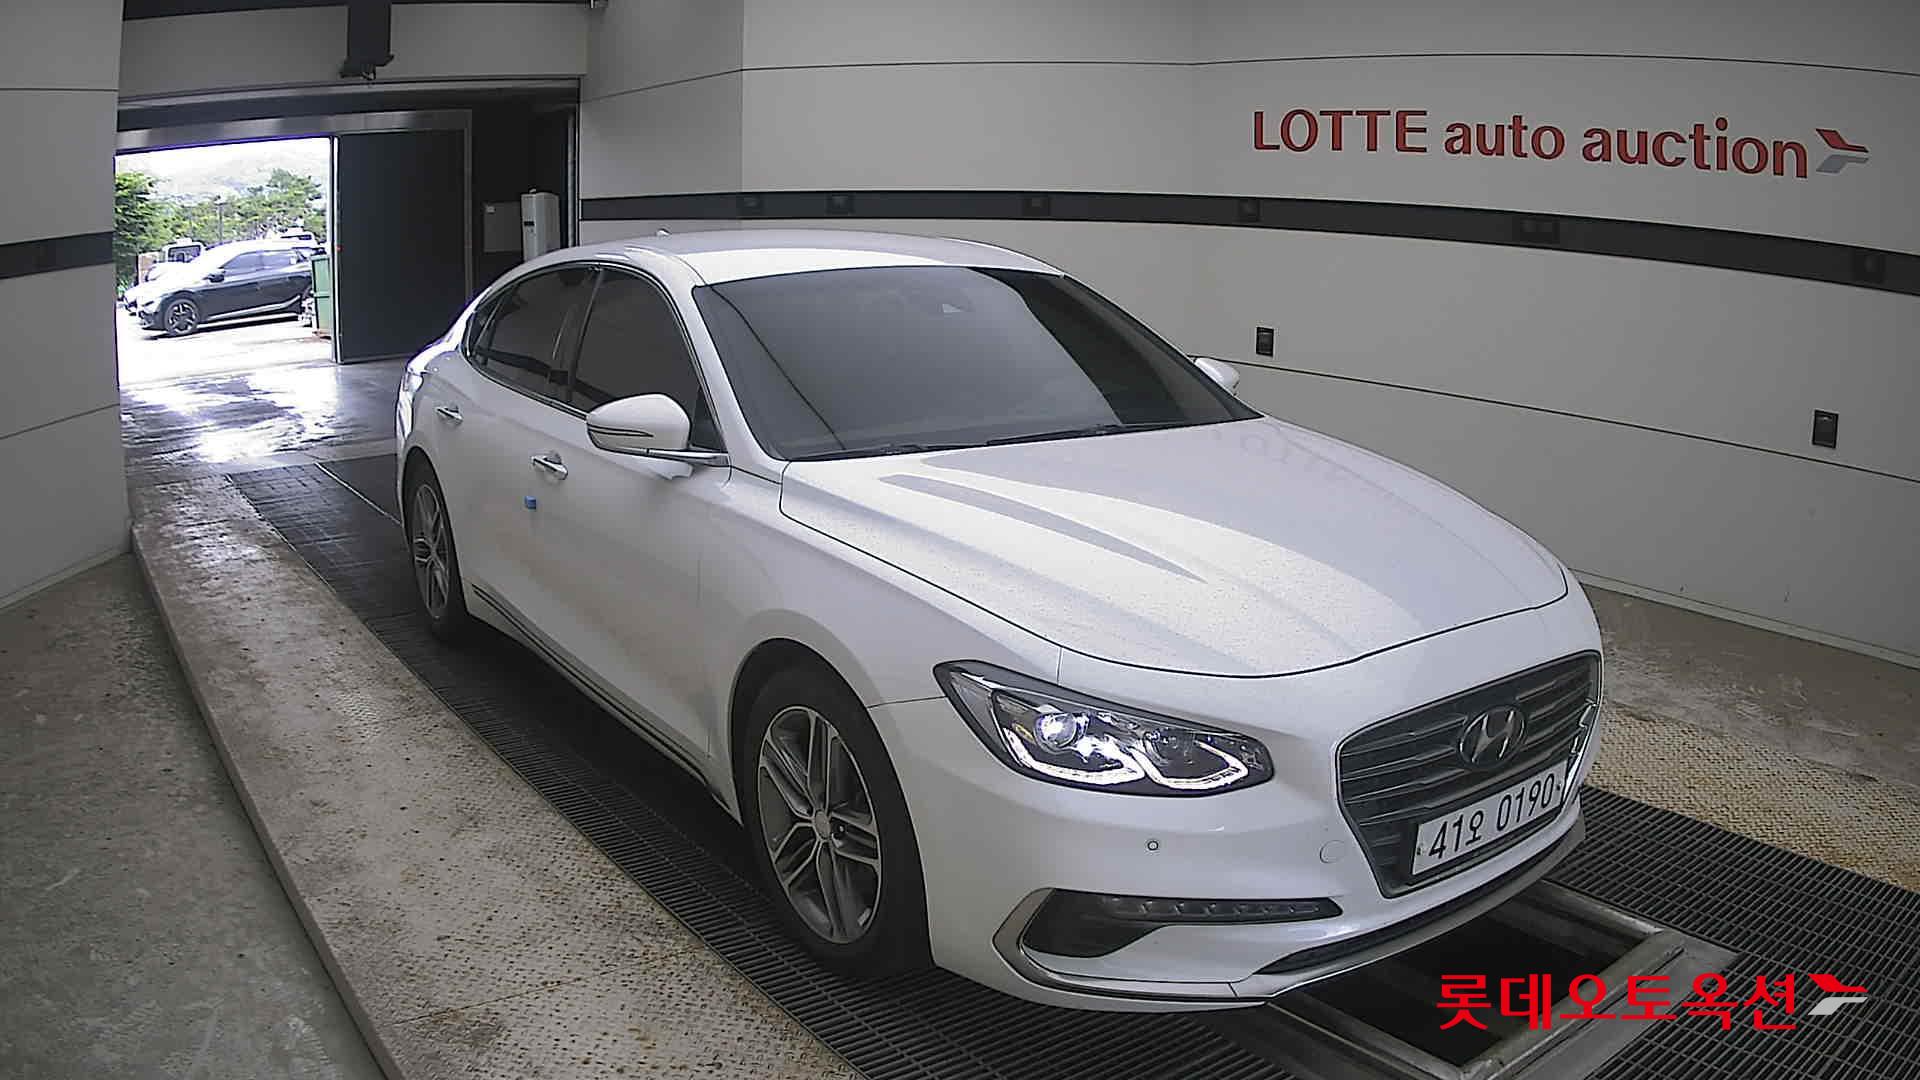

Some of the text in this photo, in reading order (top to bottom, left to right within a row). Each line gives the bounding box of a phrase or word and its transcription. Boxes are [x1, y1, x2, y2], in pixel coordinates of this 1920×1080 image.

[1253, 109, 1808, 179] LOTTE auto auction
[1428, 773, 1555, 859] 41오 0190
